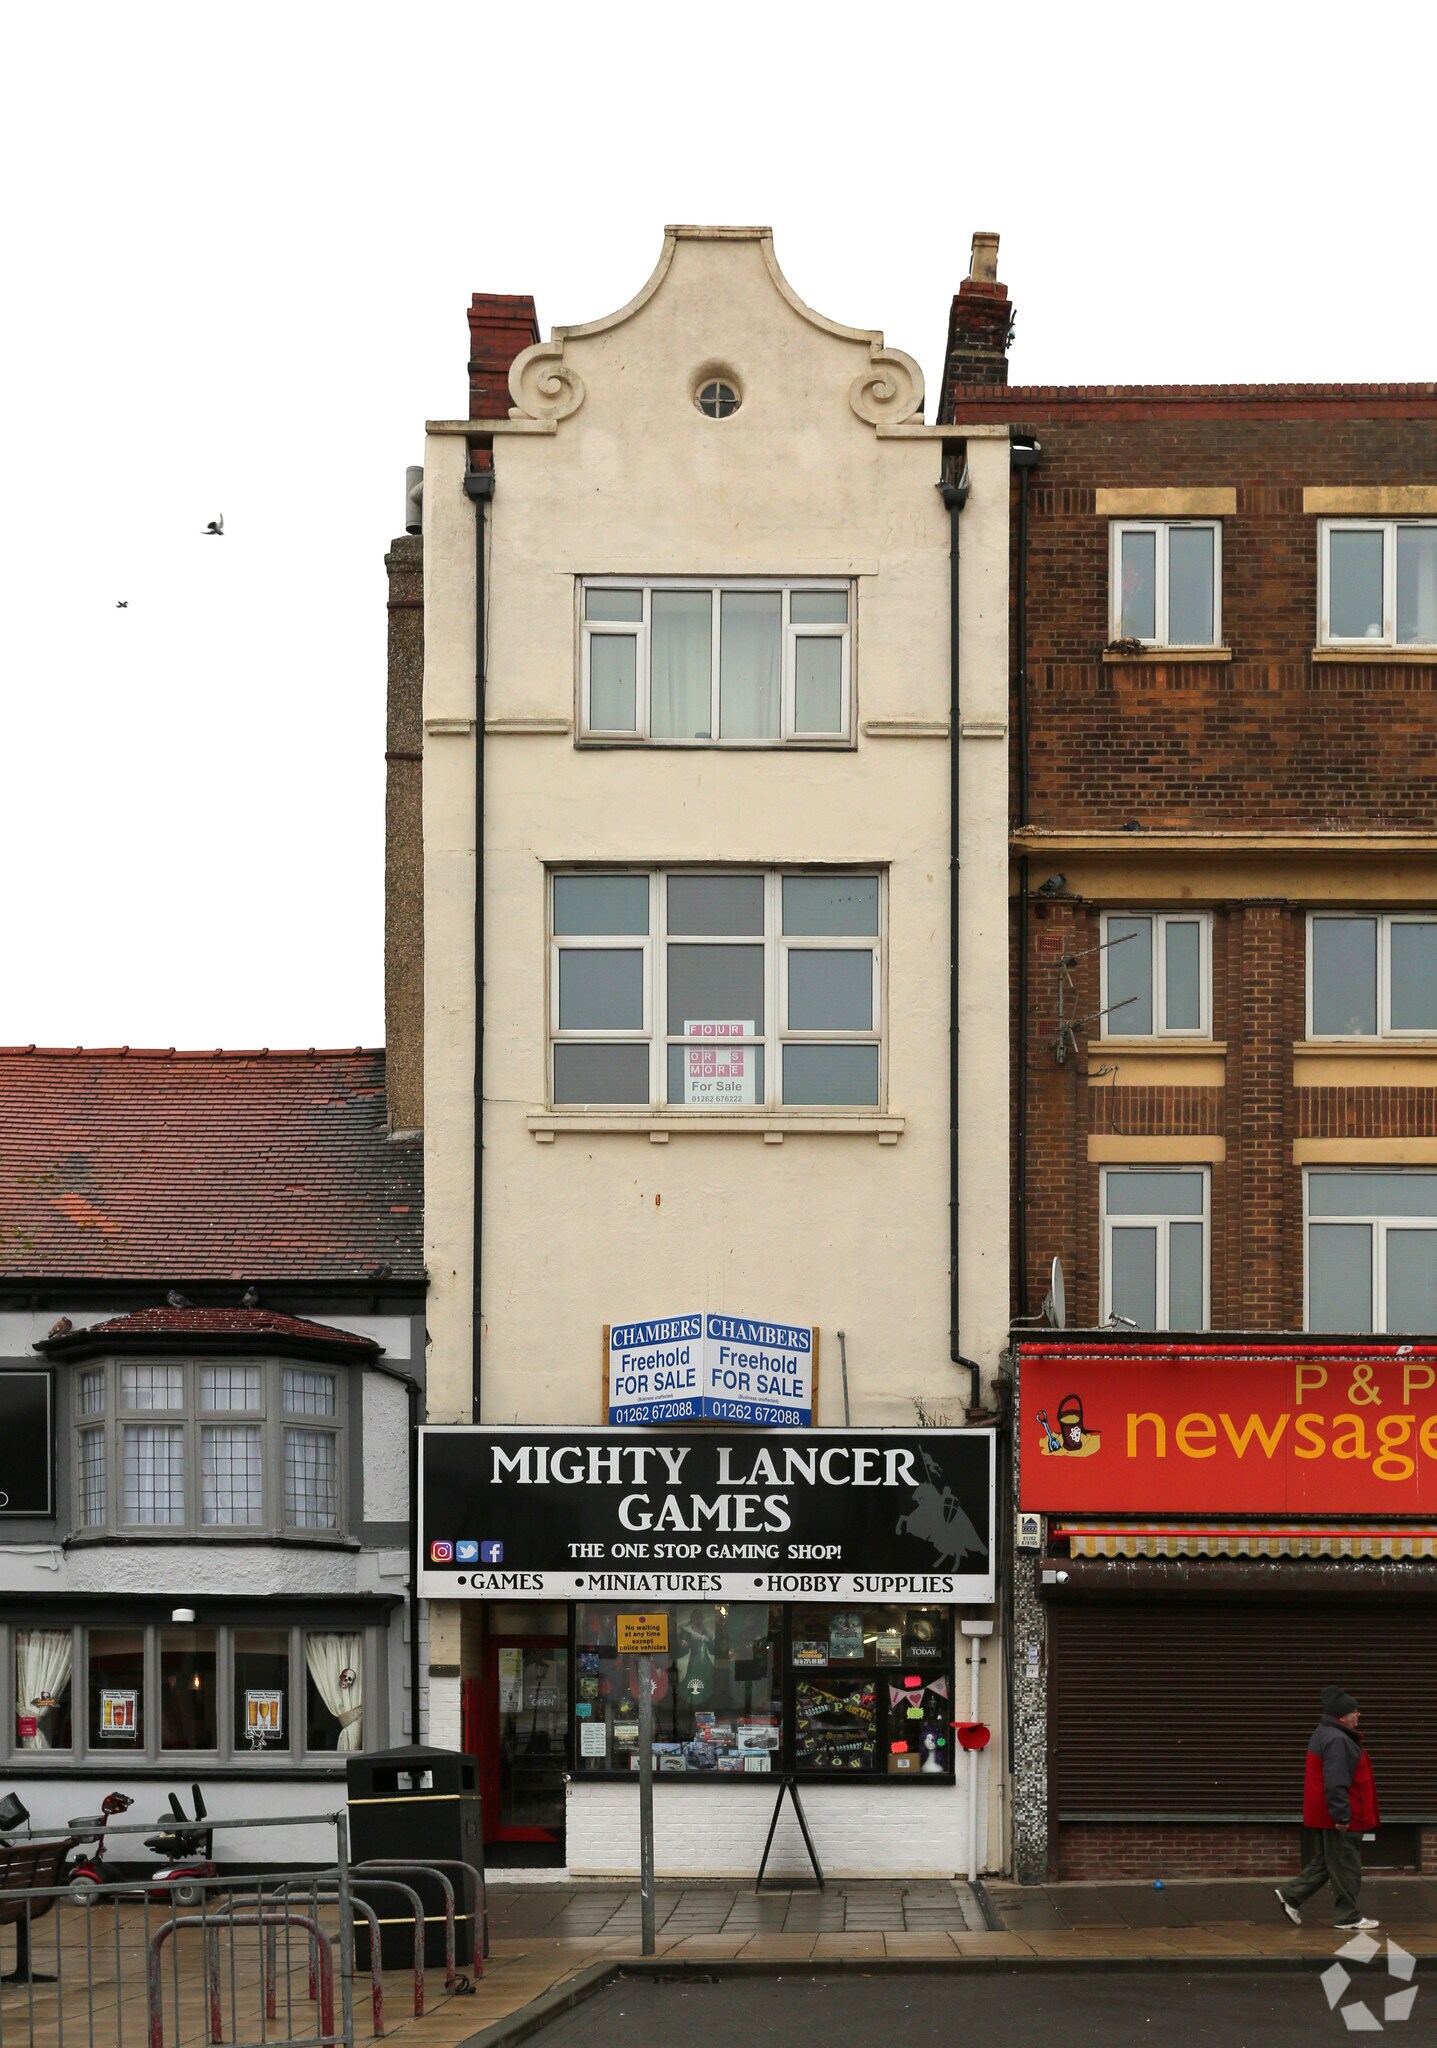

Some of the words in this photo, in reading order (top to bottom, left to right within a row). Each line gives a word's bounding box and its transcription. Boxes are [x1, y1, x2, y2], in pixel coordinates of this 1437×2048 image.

[690, 1025, 739, 1034] FOUR
[690, 1065, 738, 1074] MORE
[692, 1081, 712, 1091] For
[716, 1081, 742, 1091] Sale
[612, 1318, 700, 1347] CHAMBERS
[708, 1318, 809, 1349] CHAMBERS
[622, 1346, 690, 1373] Freehold
[720, 1346, 797, 1375] Freehold
[616, 1374, 648, 1396] FOR
[654, 1368, 696, 1391] SALE
[712, 1368, 750, 1391] FOR
[757, 1374, 803, 1398] SALE
[1296, 1364, 1328, 1405] P
[1347, 1364, 1383, 1406] &
[1403, 1365, 1436, 1406] P
[616, 1406, 649, 1423] 01262
[713, 1402, 751, 1419] 01262
[490, 1446, 691, 1484] MIGHTY
[716, 1448, 919, 1486] LANCER
[618, 1493, 791, 1532] GAMES
[568, 1543, 605, 1558] THE
[611, 1543, 649, 1558] ONE
[654, 1543, 702, 1559] STOP
[706, 1544, 779, 1559] GAMING
[788, 1544, 842, 1560] SHOP!
[470, 1573, 544, 1590] GAMES
[588, 1574, 722, 1591] MINIATURES
[767, 1575, 842, 1592] HOBBY
[853, 1576, 954, 1593] SUPPLIES
[531, 1698, 554, 1706] OPEN
